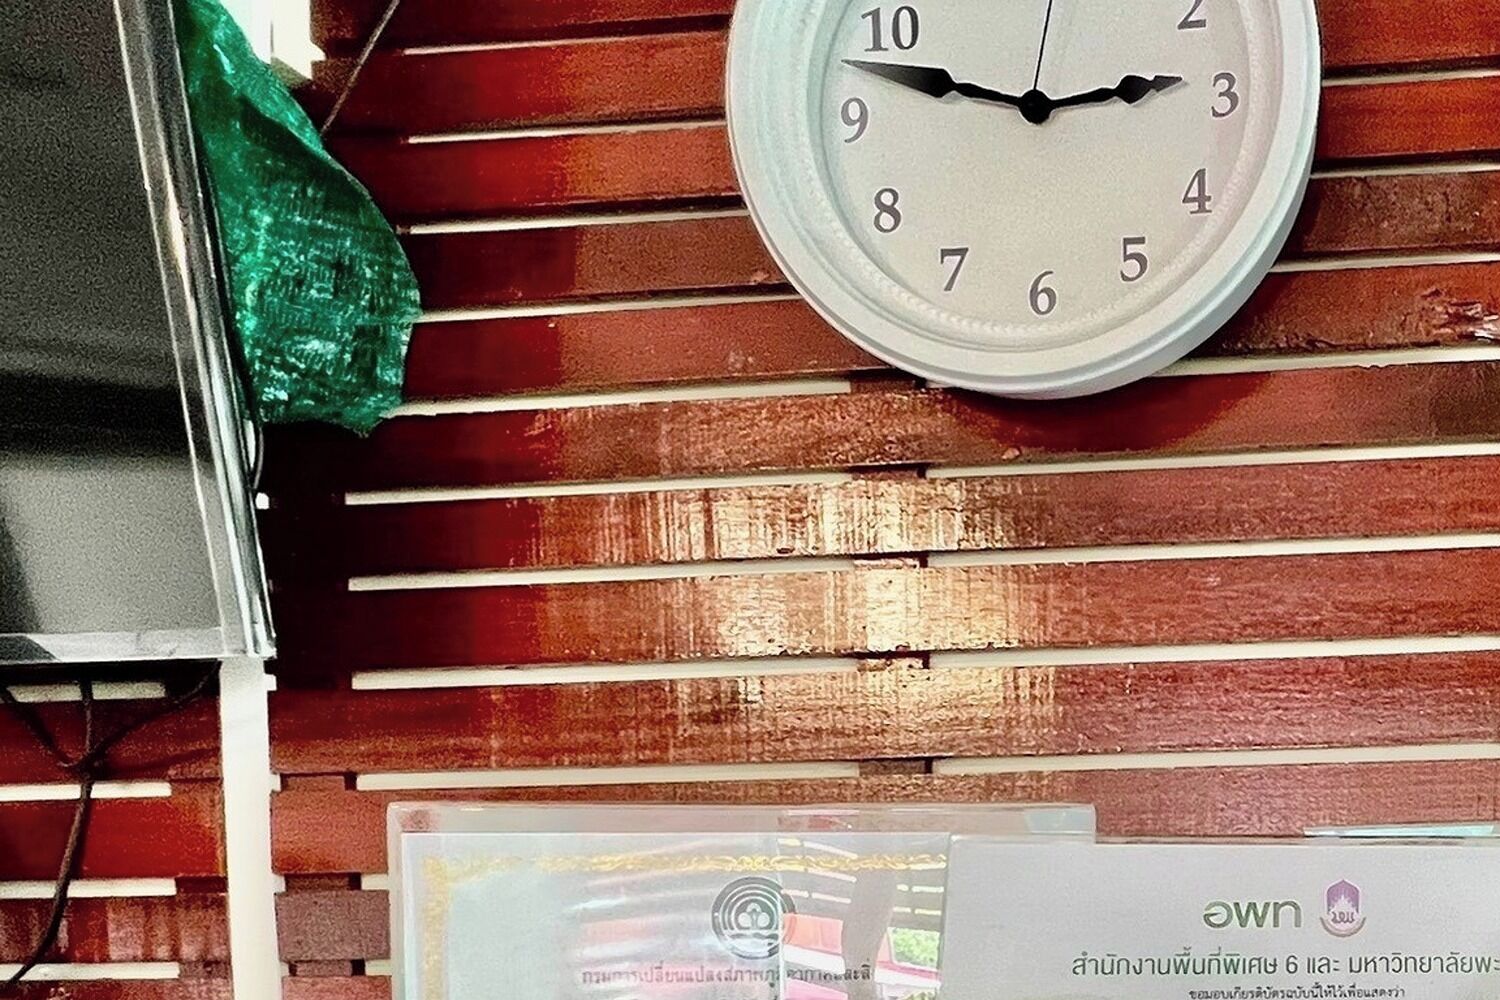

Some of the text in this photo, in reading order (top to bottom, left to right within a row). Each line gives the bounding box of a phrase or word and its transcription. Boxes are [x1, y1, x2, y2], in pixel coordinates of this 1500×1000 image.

[861, 5, 920, 53] 10
[1177, 0, 1207, 30] 2
[1210, 72, 1240, 118] 3
[840, 97, 869, 144] 9
[872, 187, 903, 234] 8
[1181, 168, 1212, 215] 4
[938, 247, 970, 292] 7
[1119, 236, 1148, 283] 5
[1028, 270, 1058, 316] 6
[1203, 899, 1302, 929] อพท
[1072, 946, 1278, 976] สำนักงานพื้นที่พิเศษ
[1286, 955, 1299, 975] 6
[1306, 955, 1341, 975] และ
